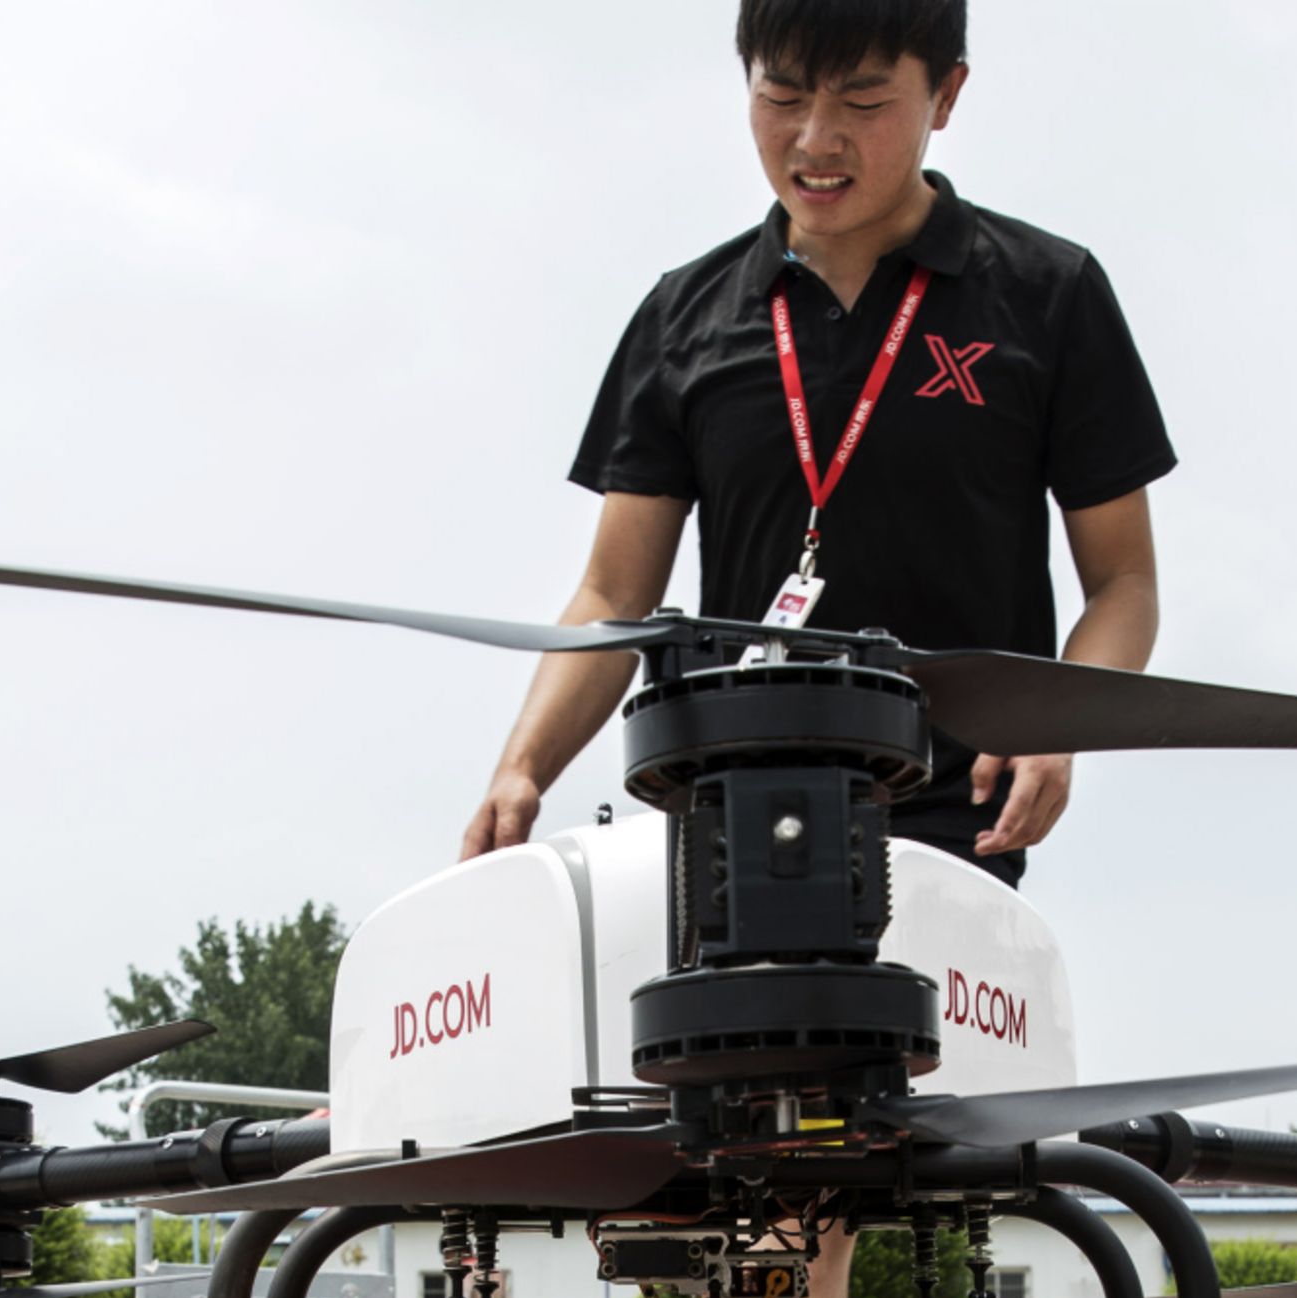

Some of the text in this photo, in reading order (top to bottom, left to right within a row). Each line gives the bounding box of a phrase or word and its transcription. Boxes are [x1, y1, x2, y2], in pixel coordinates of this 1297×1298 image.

[788, 398, 808, 438] JD.COM
[389, 972, 491, 1060] JD.COM
[944, 967, 1027, 1049] JD.COM
